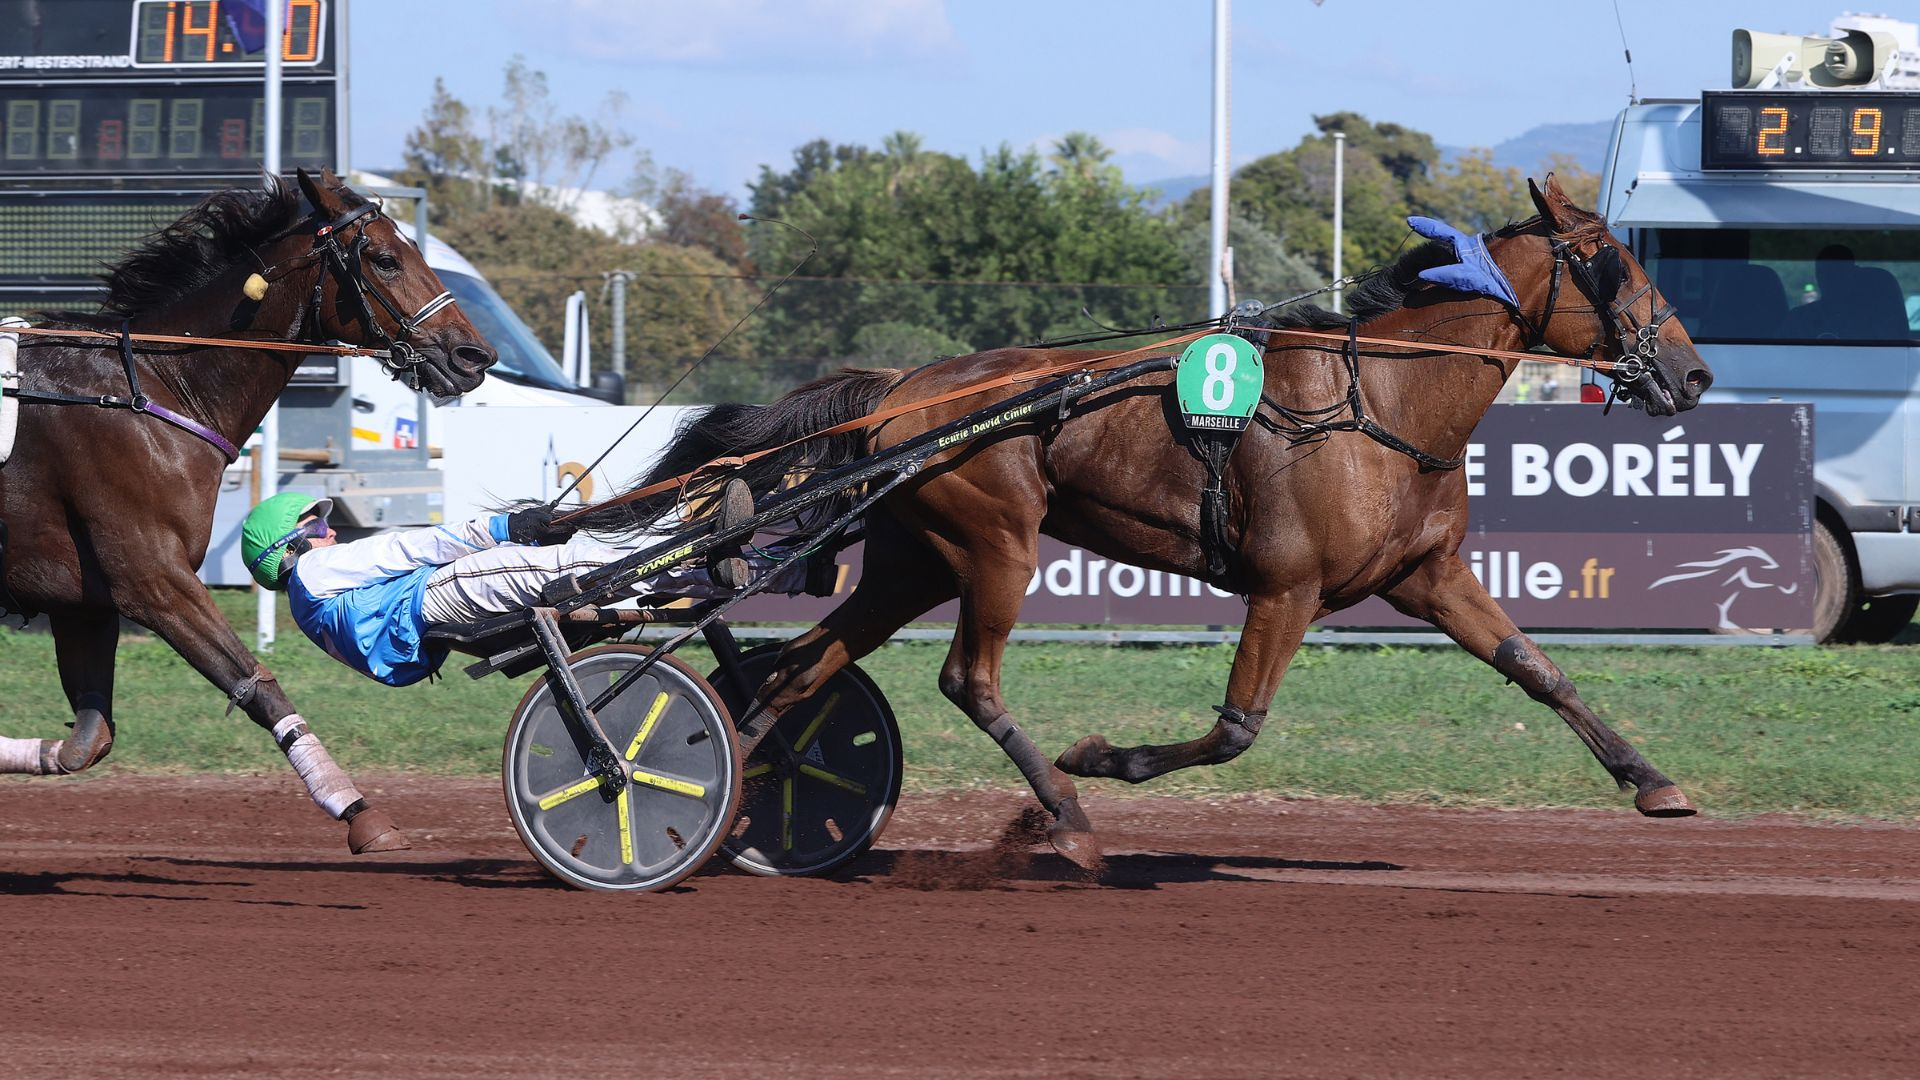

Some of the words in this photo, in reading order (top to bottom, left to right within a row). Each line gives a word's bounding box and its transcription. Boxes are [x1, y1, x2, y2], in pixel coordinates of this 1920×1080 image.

[1202, 343, 1237, 411] 8
[938, 429, 969, 447] Ecurie
[972, 415, 1001, 433] David
[1191, 416, 1240, 429] MARSEILLE
[1511, 425, 1764, 497] BORÉLY
[636, 545, 694, 575] YANKEE
